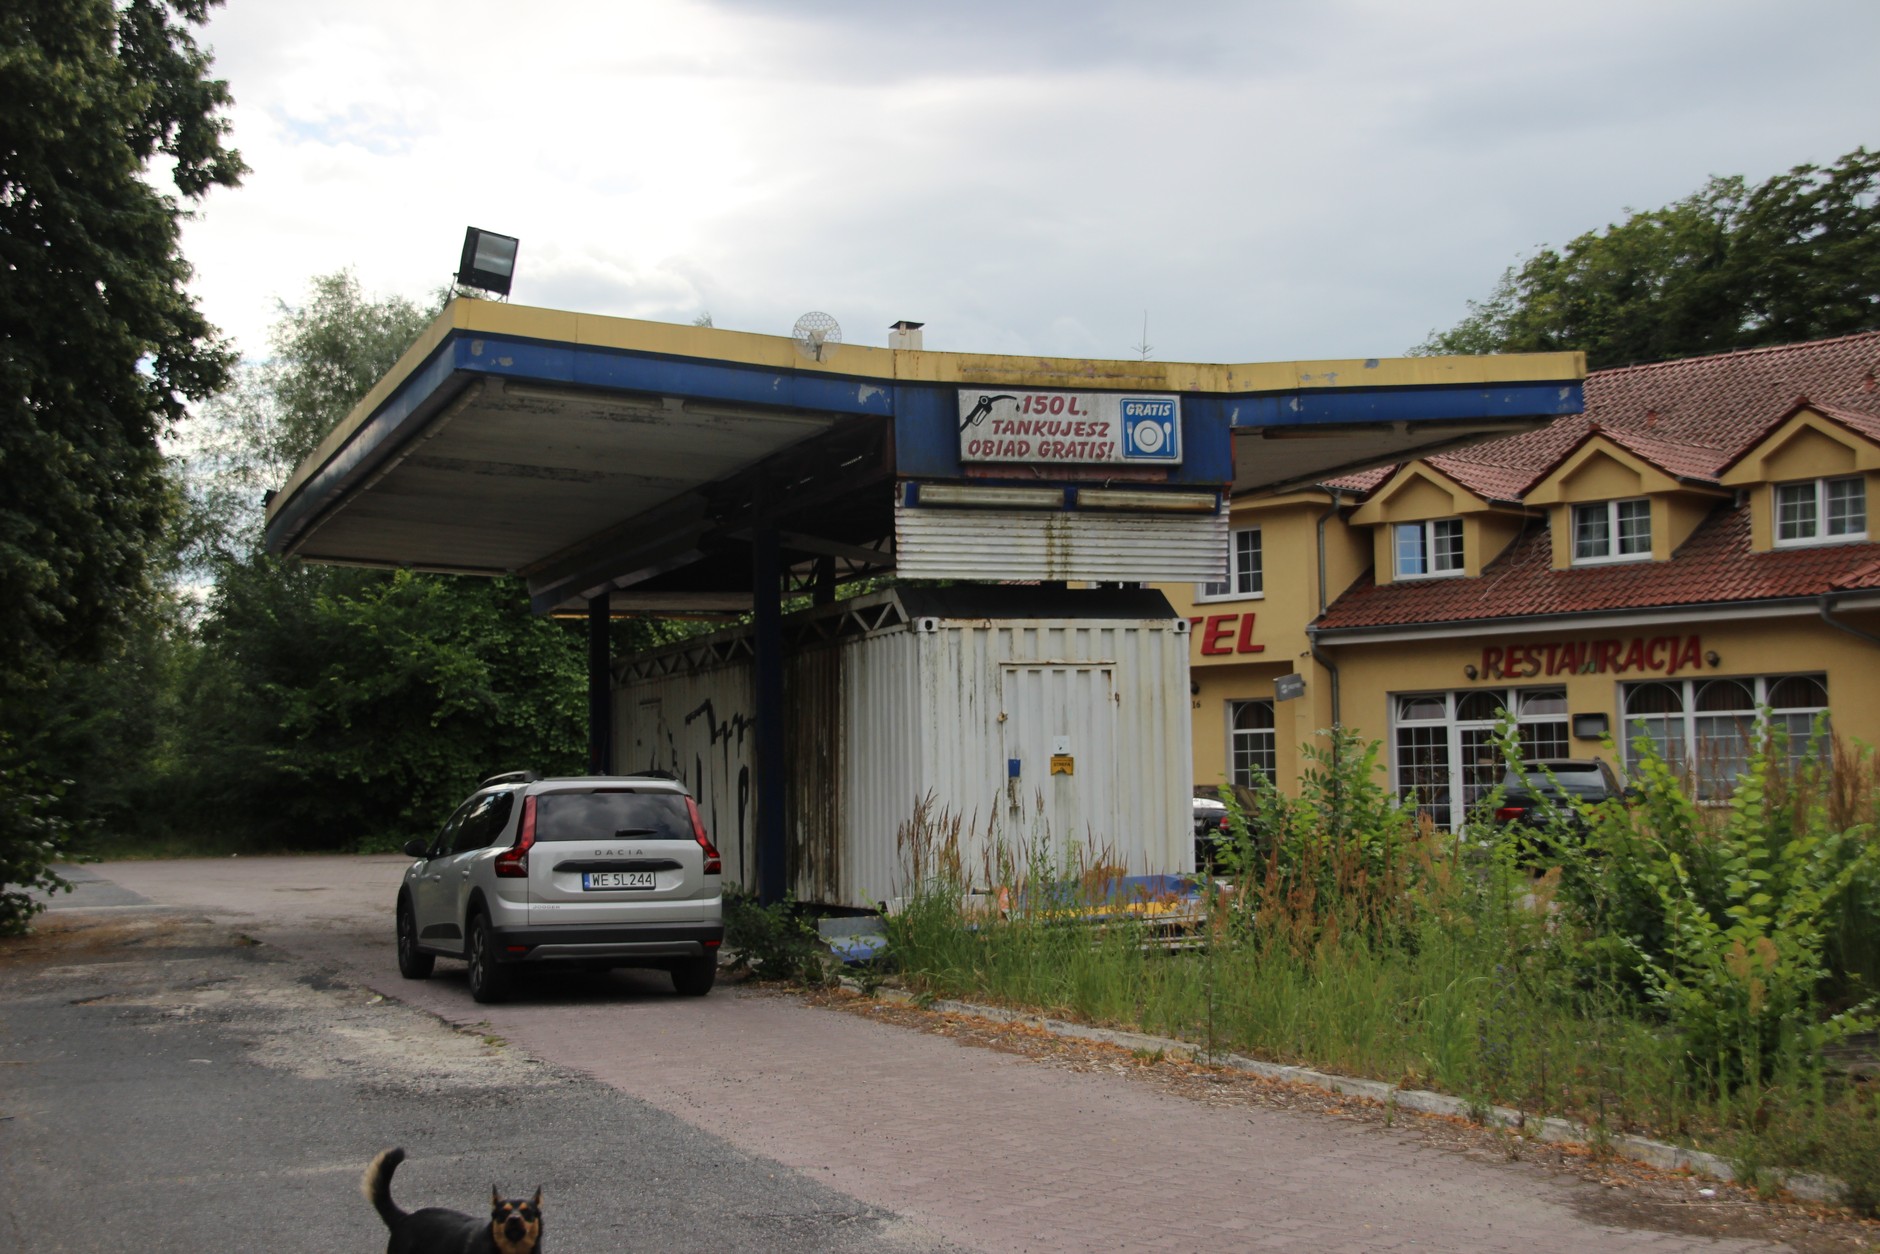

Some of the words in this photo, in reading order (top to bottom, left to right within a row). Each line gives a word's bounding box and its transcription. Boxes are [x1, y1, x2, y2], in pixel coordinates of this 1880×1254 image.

[1126, 403, 1172, 416] GRATIS
[992, 420, 1110, 438] TANKUJESZ
[968, 440, 1030, 457] OBIAD
[1038, 442, 1115, 459] GRATIS!
[1481, 636, 1702, 679] RESTAURACJA
[592, 874, 609, 886] WE
[613, 873, 652, 886] 5L244
